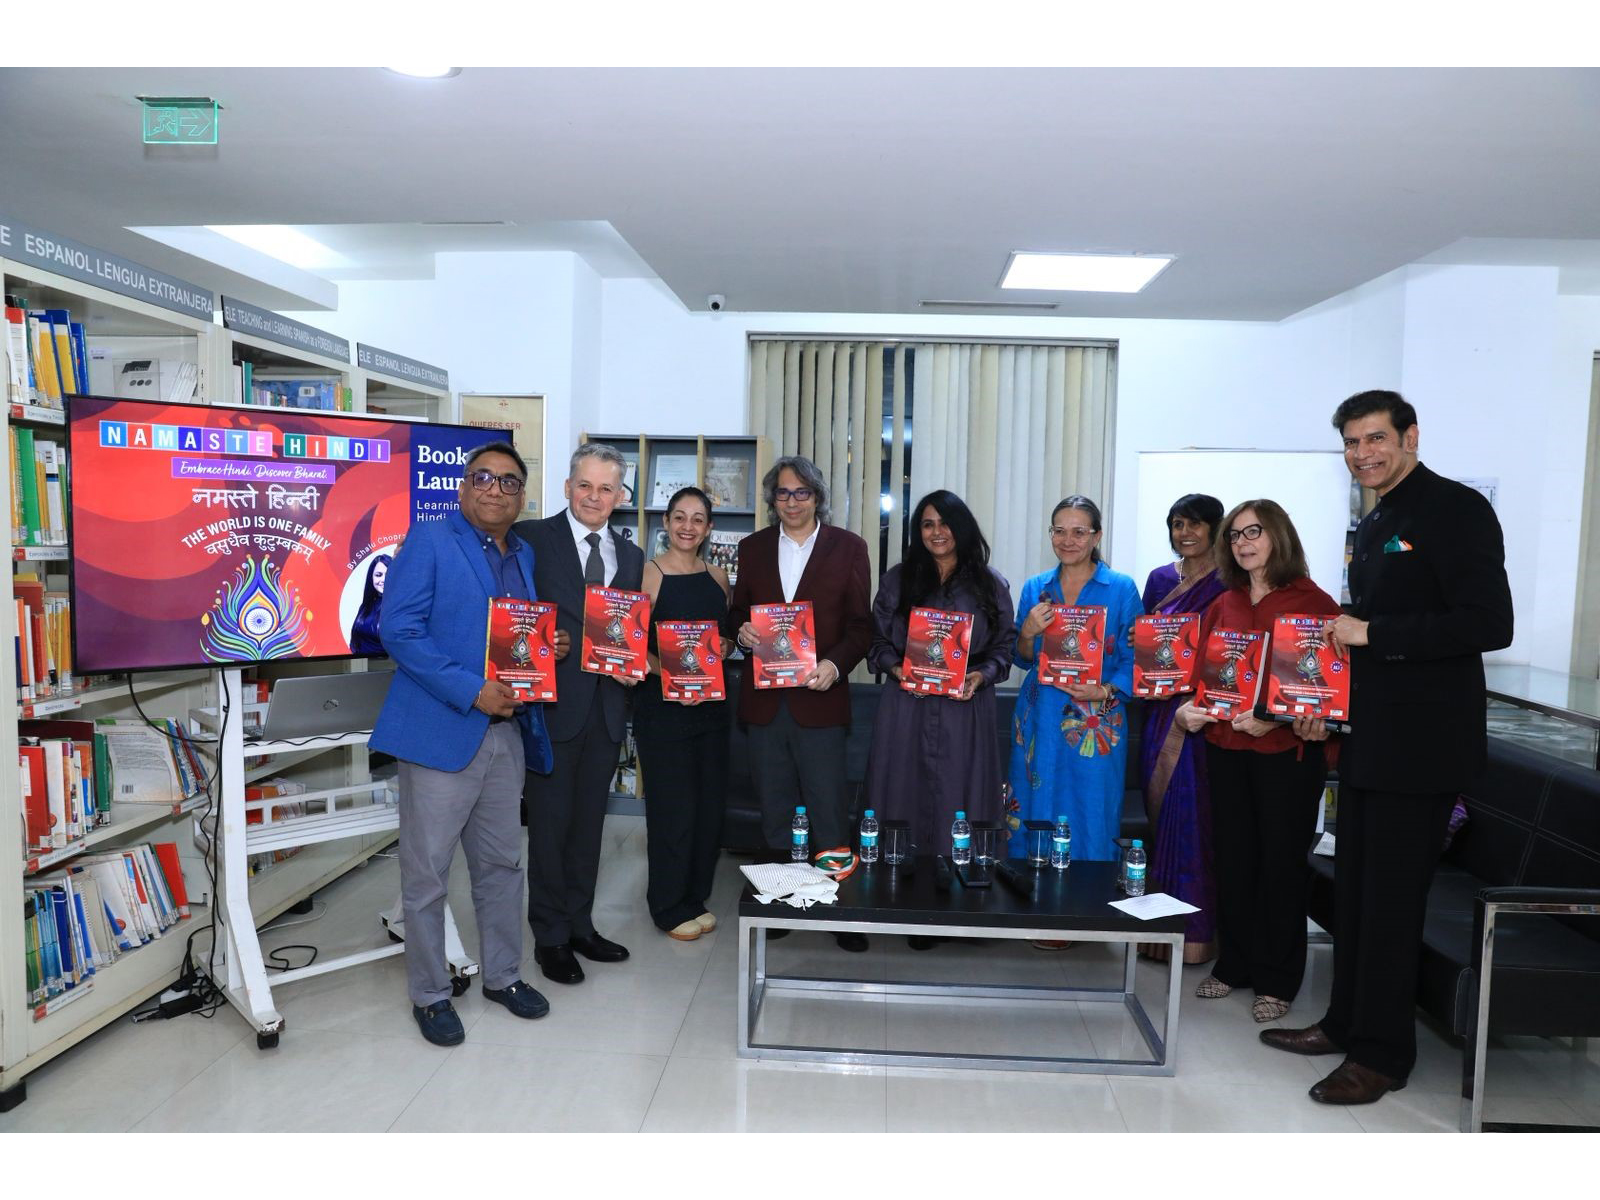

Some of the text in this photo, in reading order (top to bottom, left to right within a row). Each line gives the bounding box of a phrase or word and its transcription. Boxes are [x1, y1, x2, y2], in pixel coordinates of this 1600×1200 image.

[25, 233, 93, 273] ESPANOL
[96, 258, 148, 292] LENGUA
[148, 278, 213, 313] EXTRANJERA
[225, 306, 236, 322] ELE
[238, 309, 263, 330] TEACHING
[263, 318, 272, 332] and
[271, 320, 293, 339] LEARNING
[359, 349, 448, 385] ELE ESPANOL LENGUA EXTRANJERA
[107, 426, 382, 460] NAMASTE HINDI
[417, 445, 467, 465] Book
[192, 484, 320, 511] नमस्ते हिन्दी
[181, 515, 332, 551] THE WORLD IS ONE FAMILY
[204, 531, 315, 566] वसुधैव कुटुम्बकम्
[347, 559, 356, 571] By
[355, 541, 376, 560] Shalu
